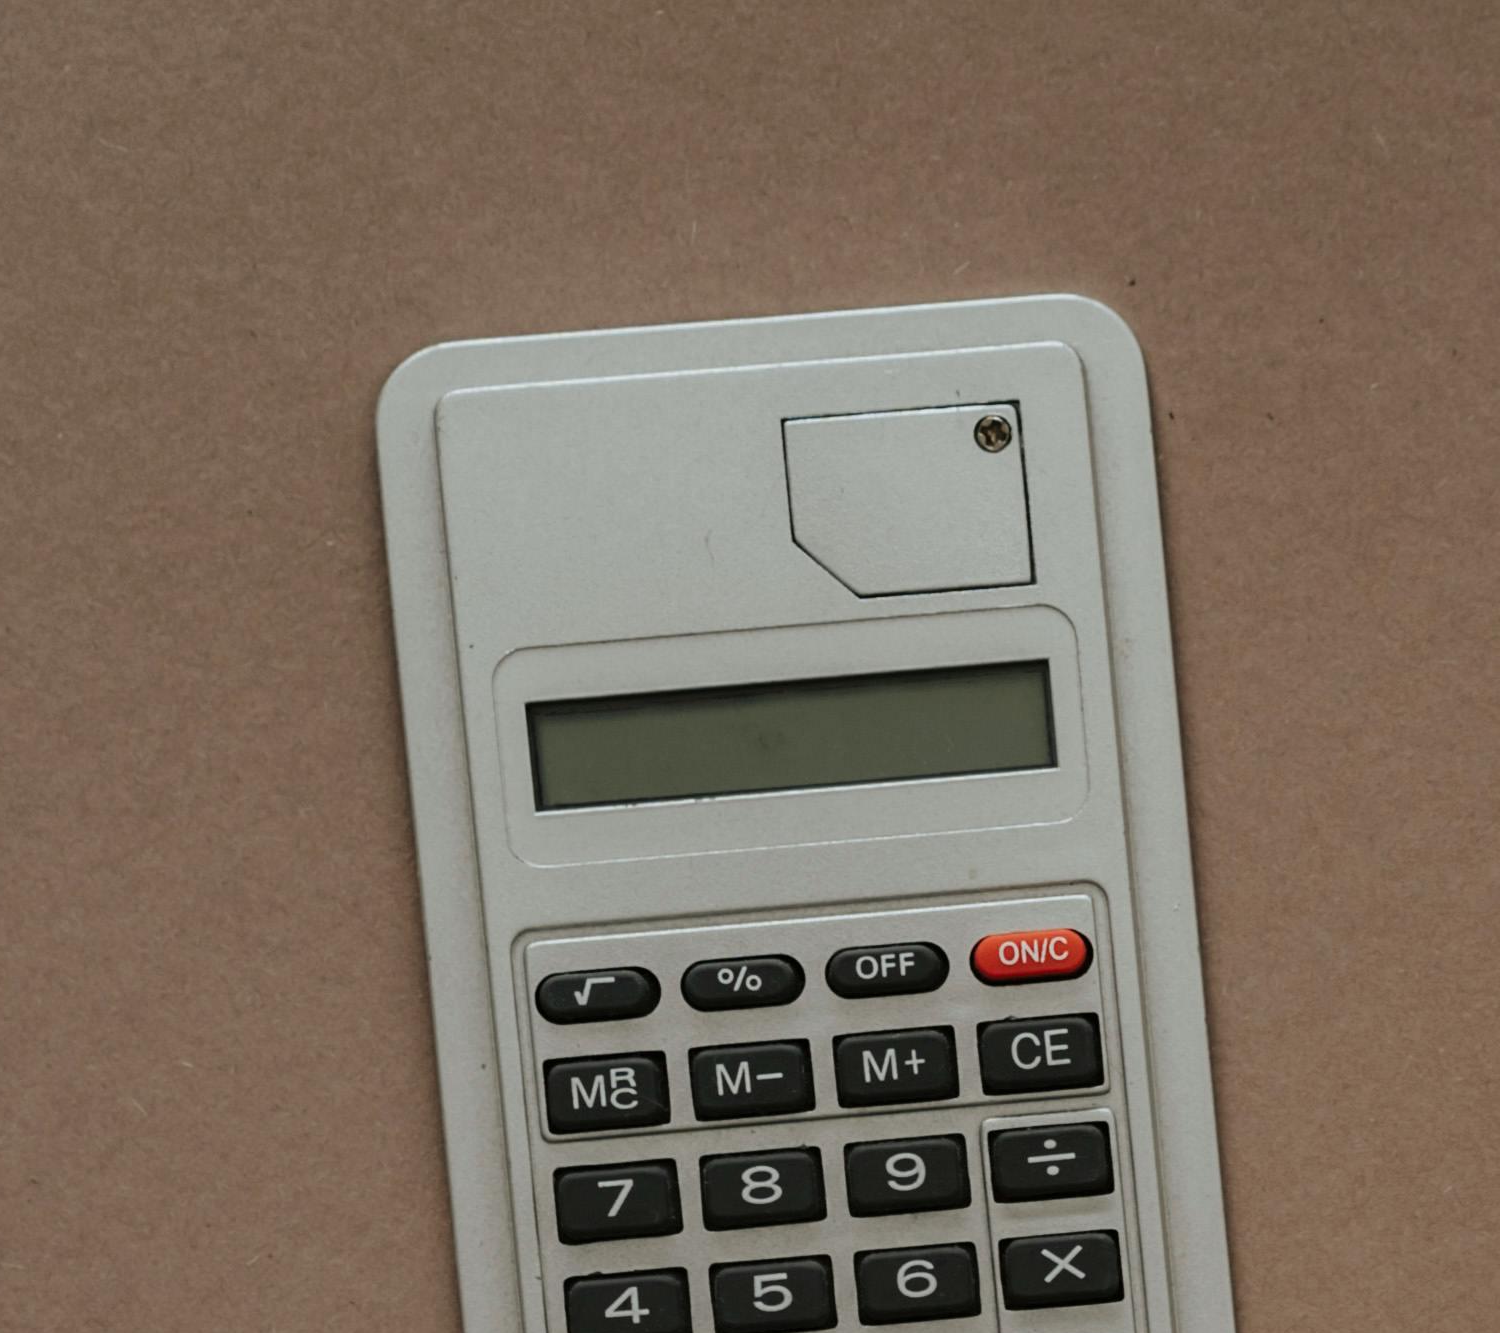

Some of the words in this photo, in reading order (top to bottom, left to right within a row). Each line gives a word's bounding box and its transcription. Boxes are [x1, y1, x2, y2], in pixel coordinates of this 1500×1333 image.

[856, 950, 914, 979] OFF
[998, 936, 1068, 965] ON/C
[718, 966, 761, 991] %
[1012, 1029, 1070, 1069] CE
[742, 1166, 782, 1204] 8
[886, 1153, 925, 1190] 9
[598, 1179, 633, 1216] 7
[754, 1273, 792, 1311] 5
[897, 1260, 937, 1297] 6
[605, 1287, 649, 1323] 4
